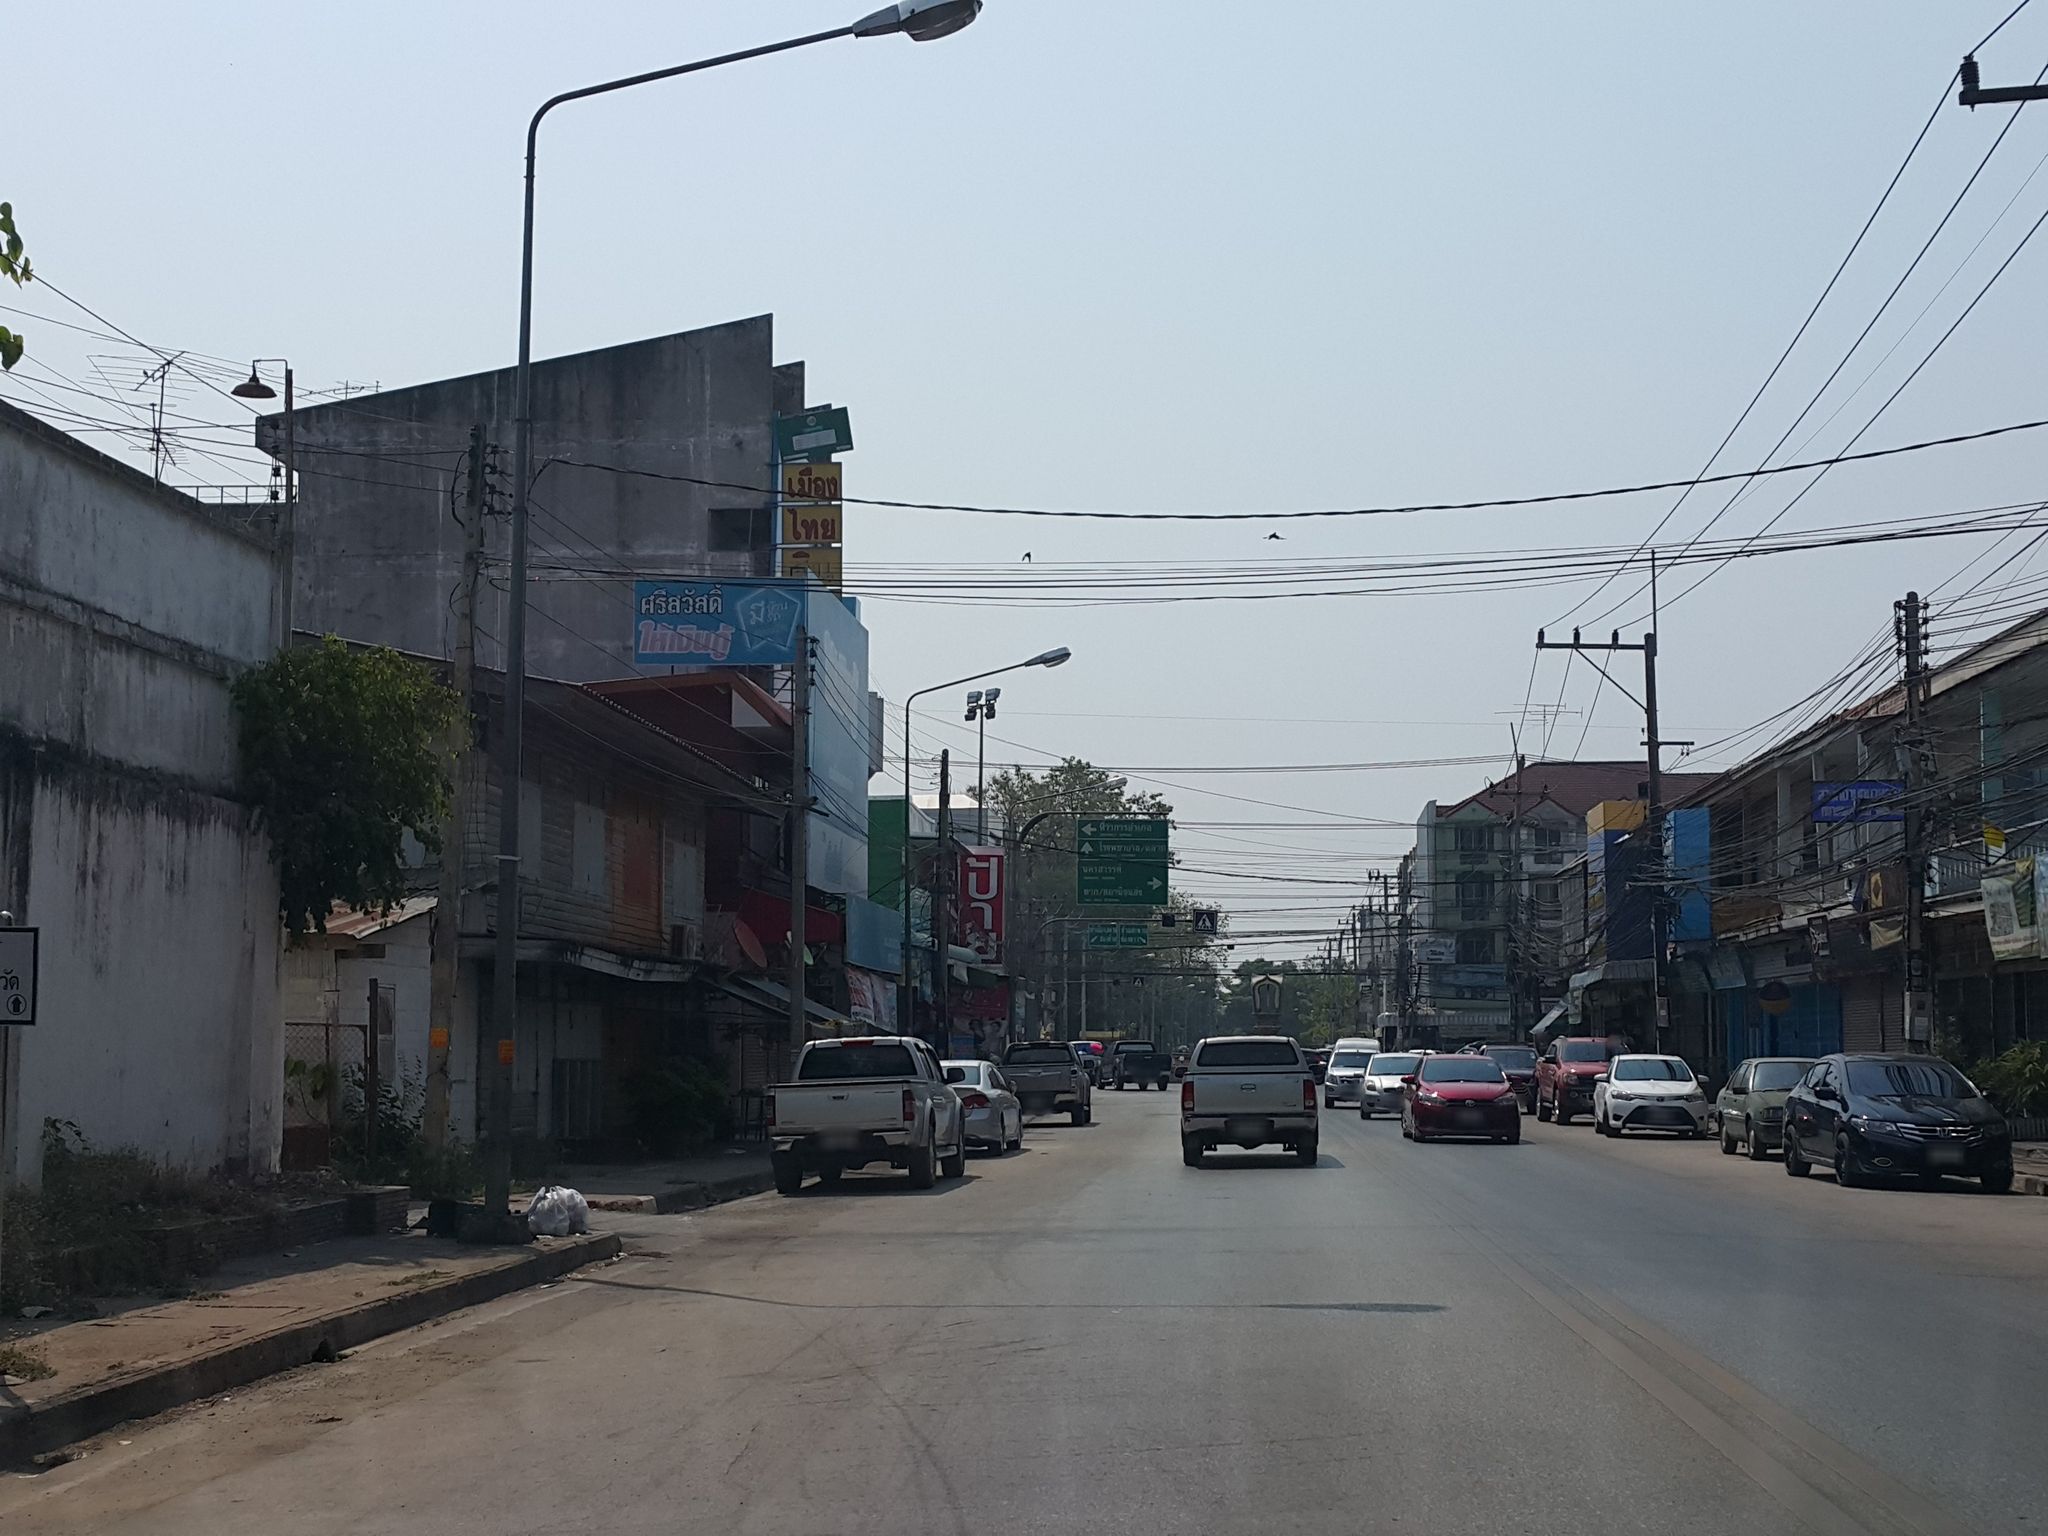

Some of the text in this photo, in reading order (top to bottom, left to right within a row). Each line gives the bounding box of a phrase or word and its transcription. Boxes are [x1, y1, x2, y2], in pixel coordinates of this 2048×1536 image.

[787, 467, 838, 498] เมือง
[787, 509, 836, 540] ไทย
[640, 584, 724, 616] ศรีสวัสดิ์
[638, 620, 736, 661] ให้เงินกู้
